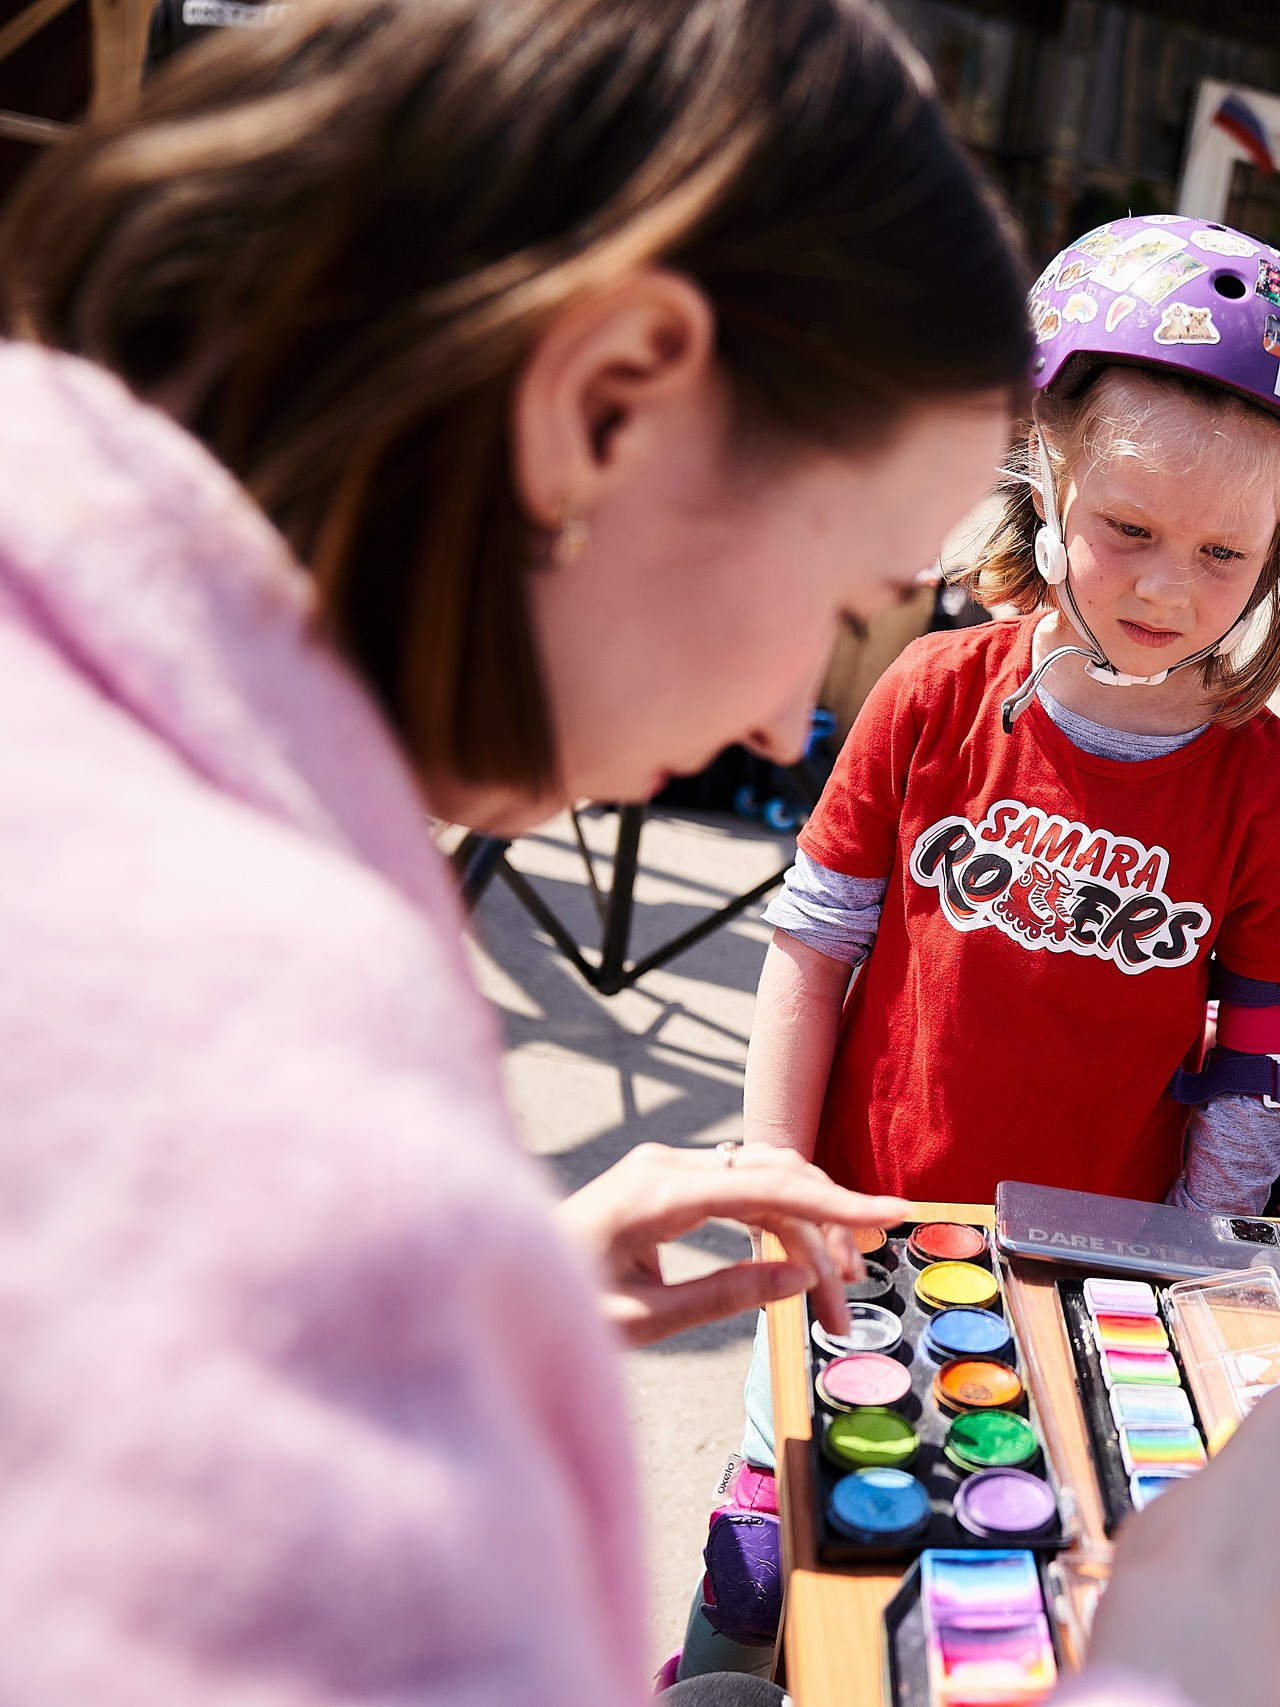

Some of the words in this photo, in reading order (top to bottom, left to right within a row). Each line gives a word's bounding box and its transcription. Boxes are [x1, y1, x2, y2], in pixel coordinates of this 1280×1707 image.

[980, 806, 1162, 892] SAMARA
[1028, 1228, 1105, 1251] DARE
[1110, 1241, 1151, 1257] TO
[717, 1462, 735, 1494] oxelo
